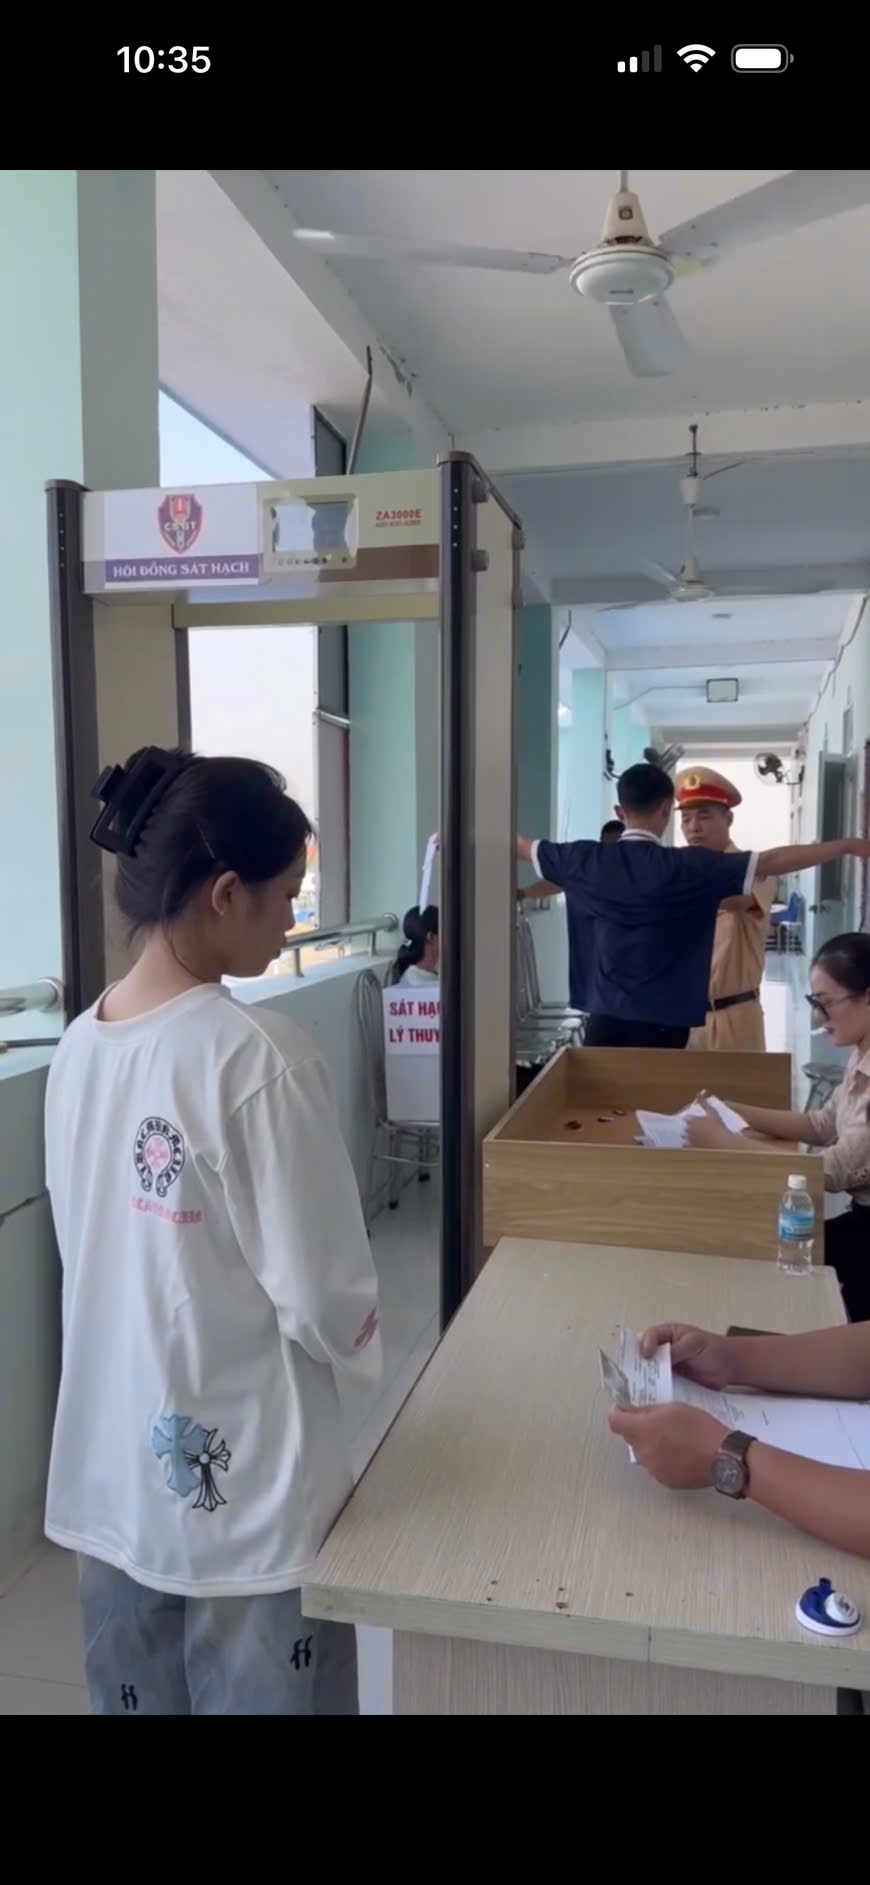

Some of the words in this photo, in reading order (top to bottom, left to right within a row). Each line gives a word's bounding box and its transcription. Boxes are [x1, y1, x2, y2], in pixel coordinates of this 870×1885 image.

[376, 508, 423, 520] ZA3000E
[389, 998, 414, 1016] SÁT
[389, 1025, 404, 1043] LÝ
